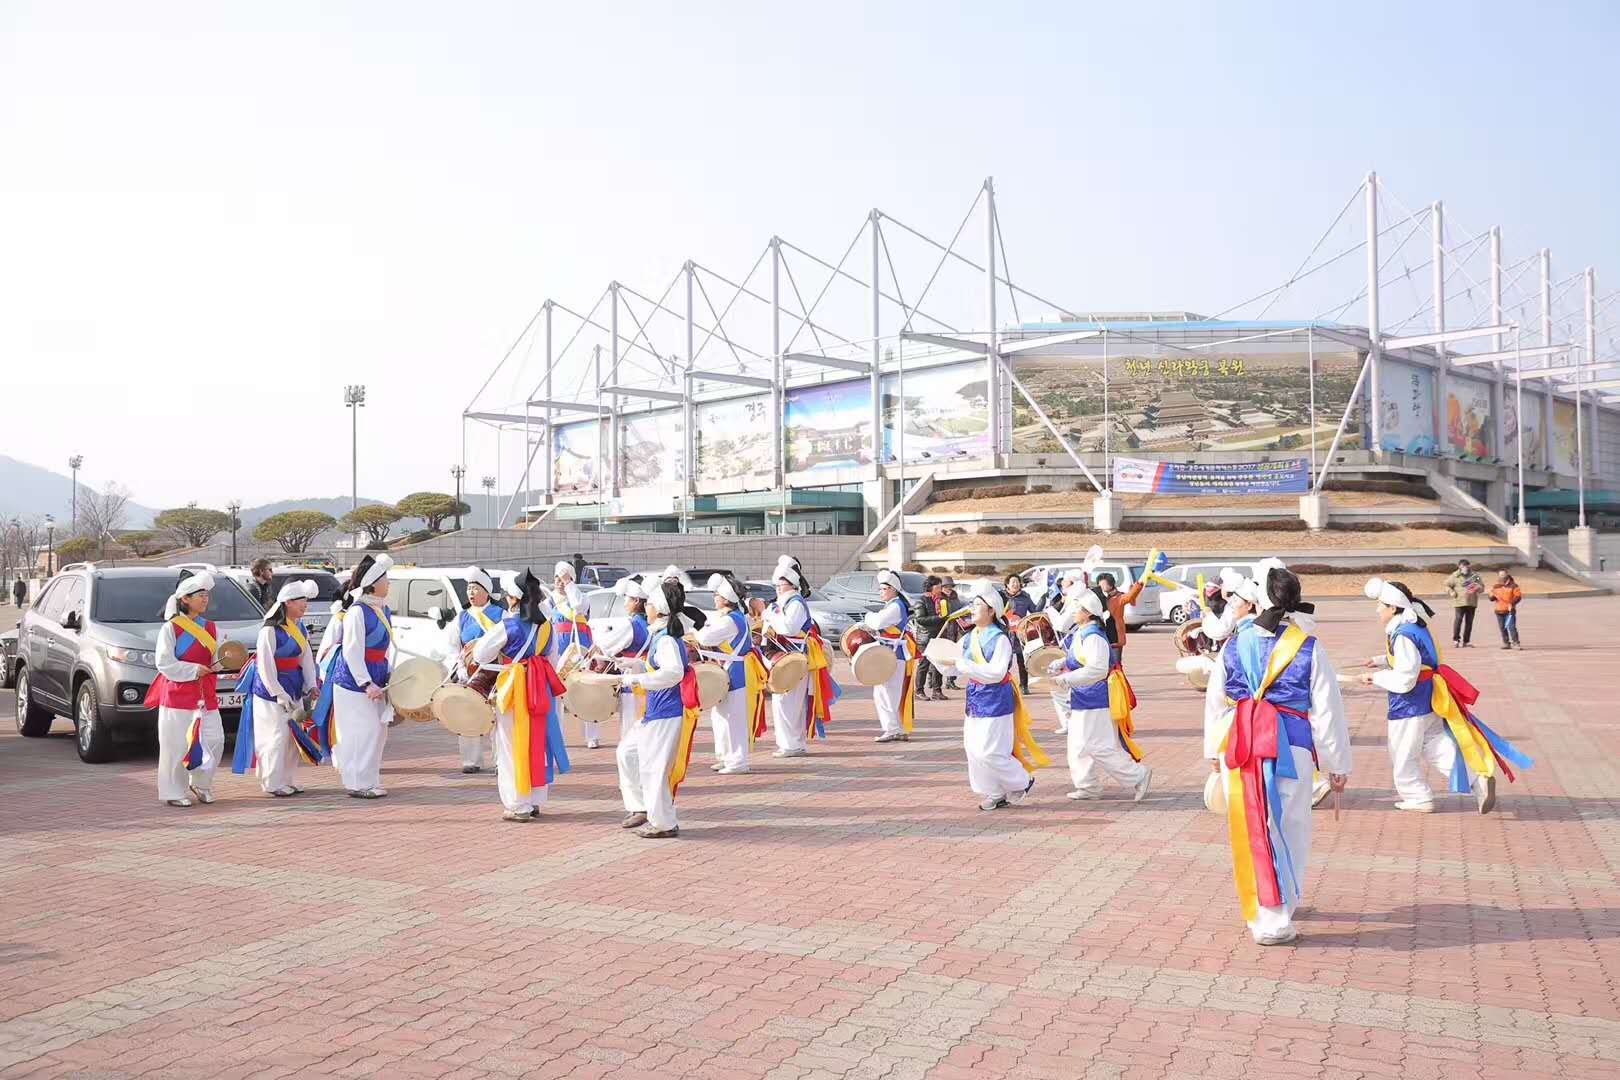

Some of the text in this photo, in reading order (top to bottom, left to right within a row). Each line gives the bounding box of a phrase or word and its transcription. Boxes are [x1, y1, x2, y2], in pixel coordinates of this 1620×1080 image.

[1125, 359, 1245, 377] 천년 신라왕궁 복원
